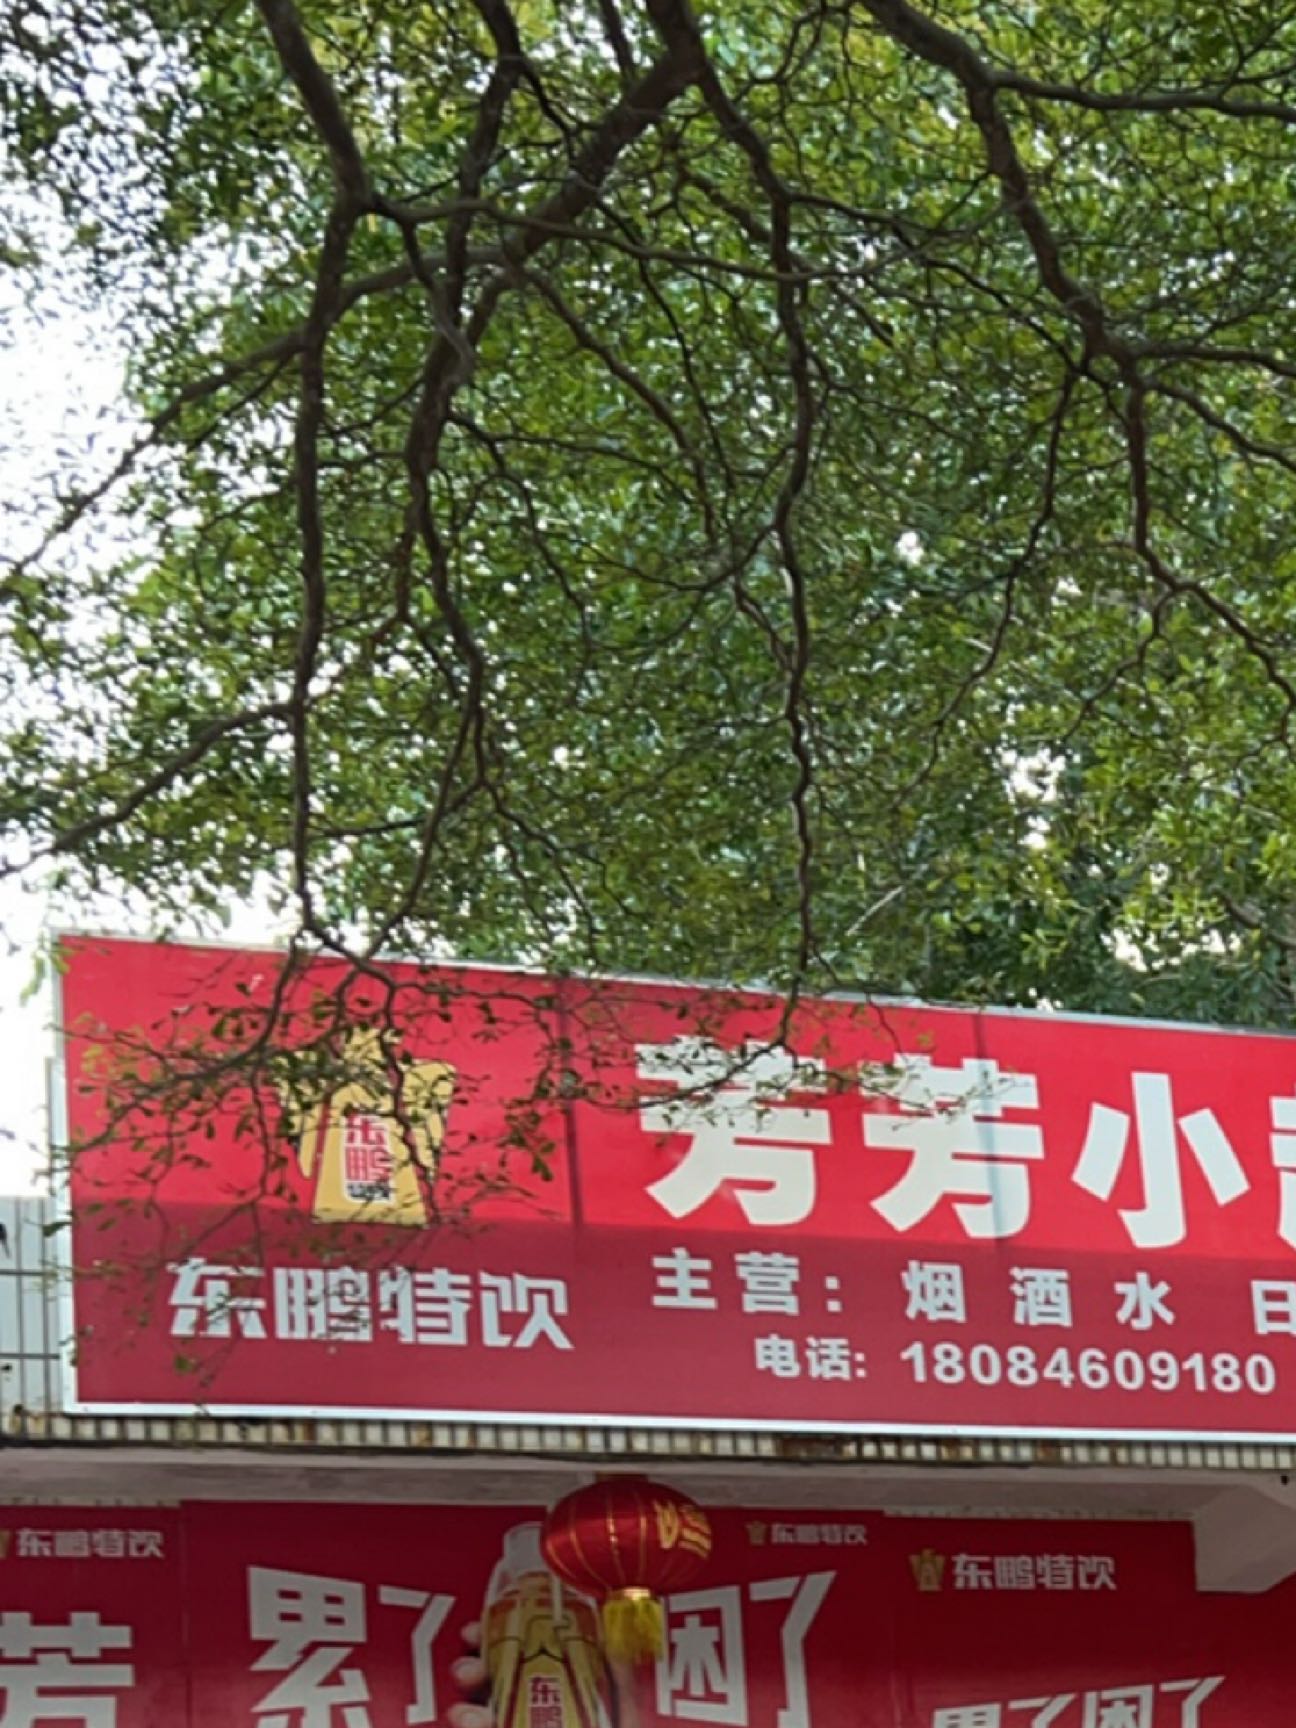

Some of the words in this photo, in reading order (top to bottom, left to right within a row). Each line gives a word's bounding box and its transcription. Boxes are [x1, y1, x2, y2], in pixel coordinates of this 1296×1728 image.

[167, 1256, 573, 1350] 东鹏特饮
[900, 1340, 1277, 1396] 18084609180
[17, 1529, 164, 1558] 东鹏特饮
[952, 1553, 1118, 1591] 东鹏特饮
